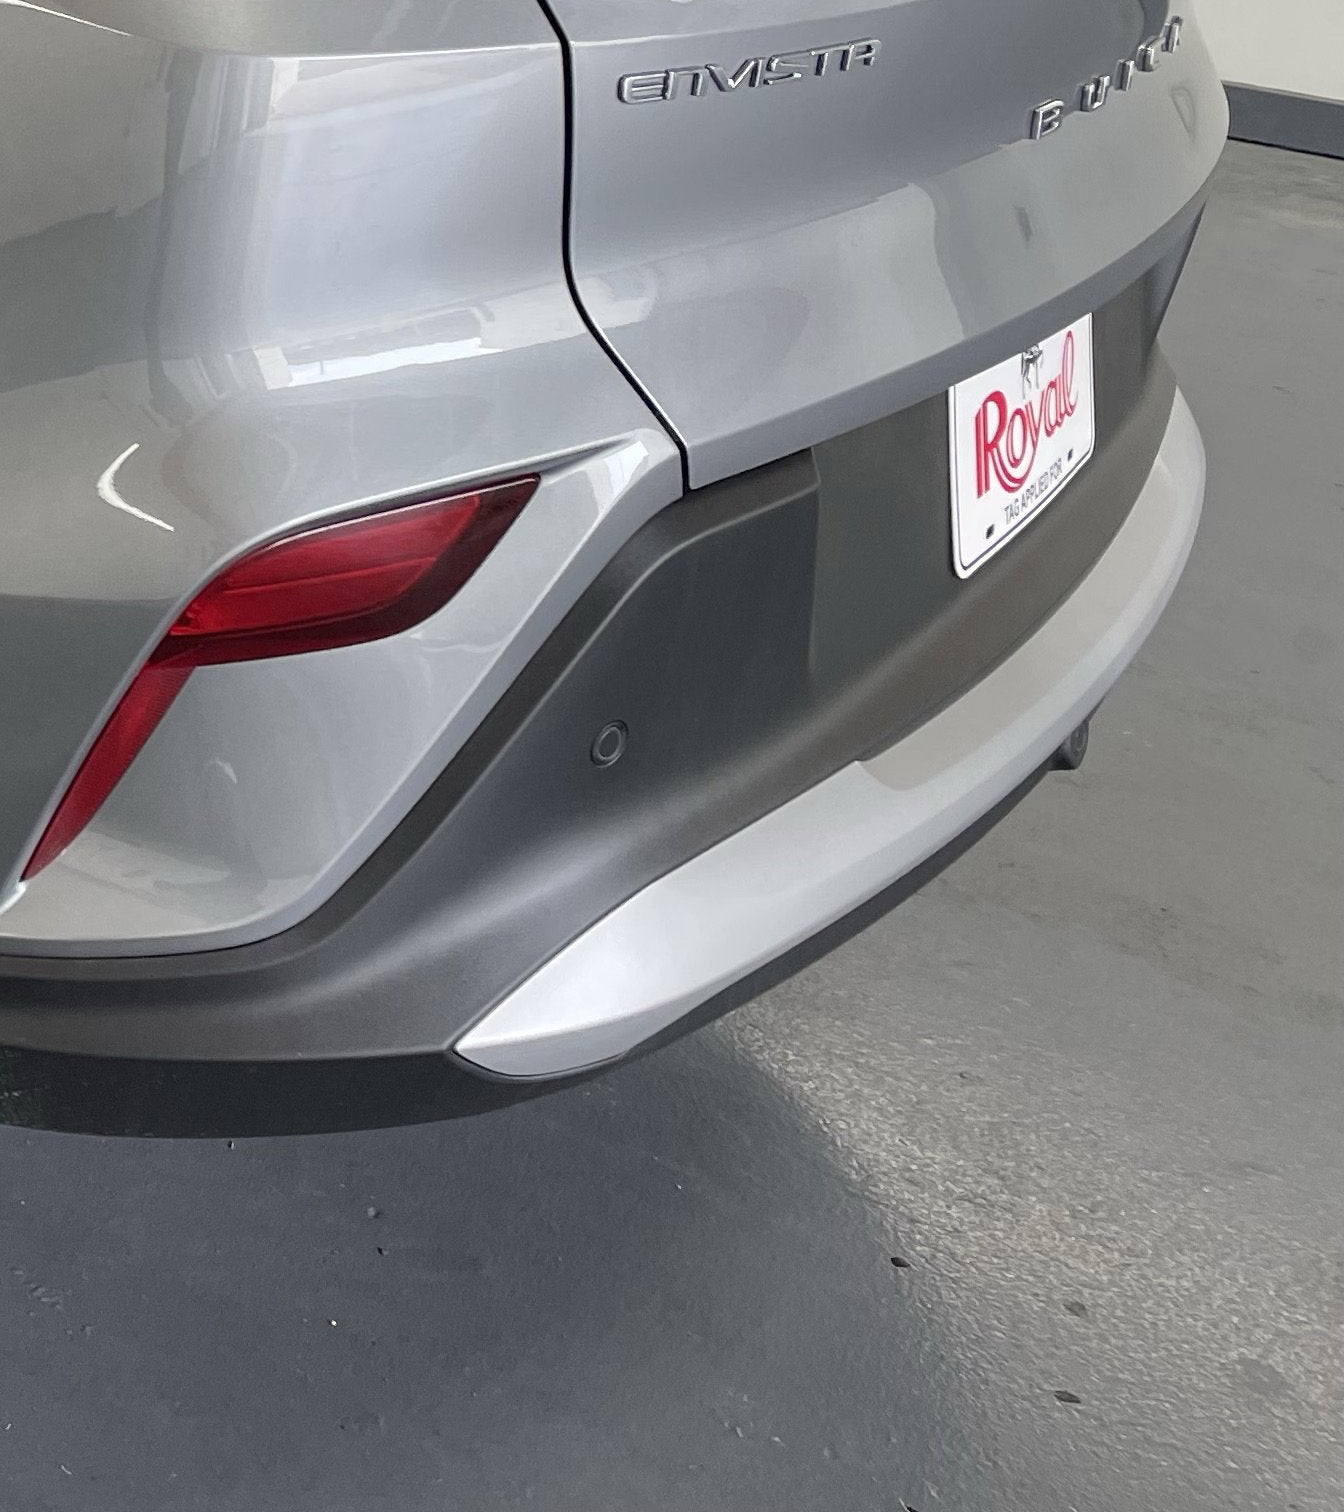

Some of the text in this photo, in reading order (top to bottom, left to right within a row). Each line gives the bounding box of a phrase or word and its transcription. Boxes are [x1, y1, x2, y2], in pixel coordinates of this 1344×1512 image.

[616, 37, 883, 106] ENVISTA
[974, 330, 1079, 499] Royal
[1004, 498, 1020, 525] TAG
[1020, 471, 1050, 512] APPLIED
